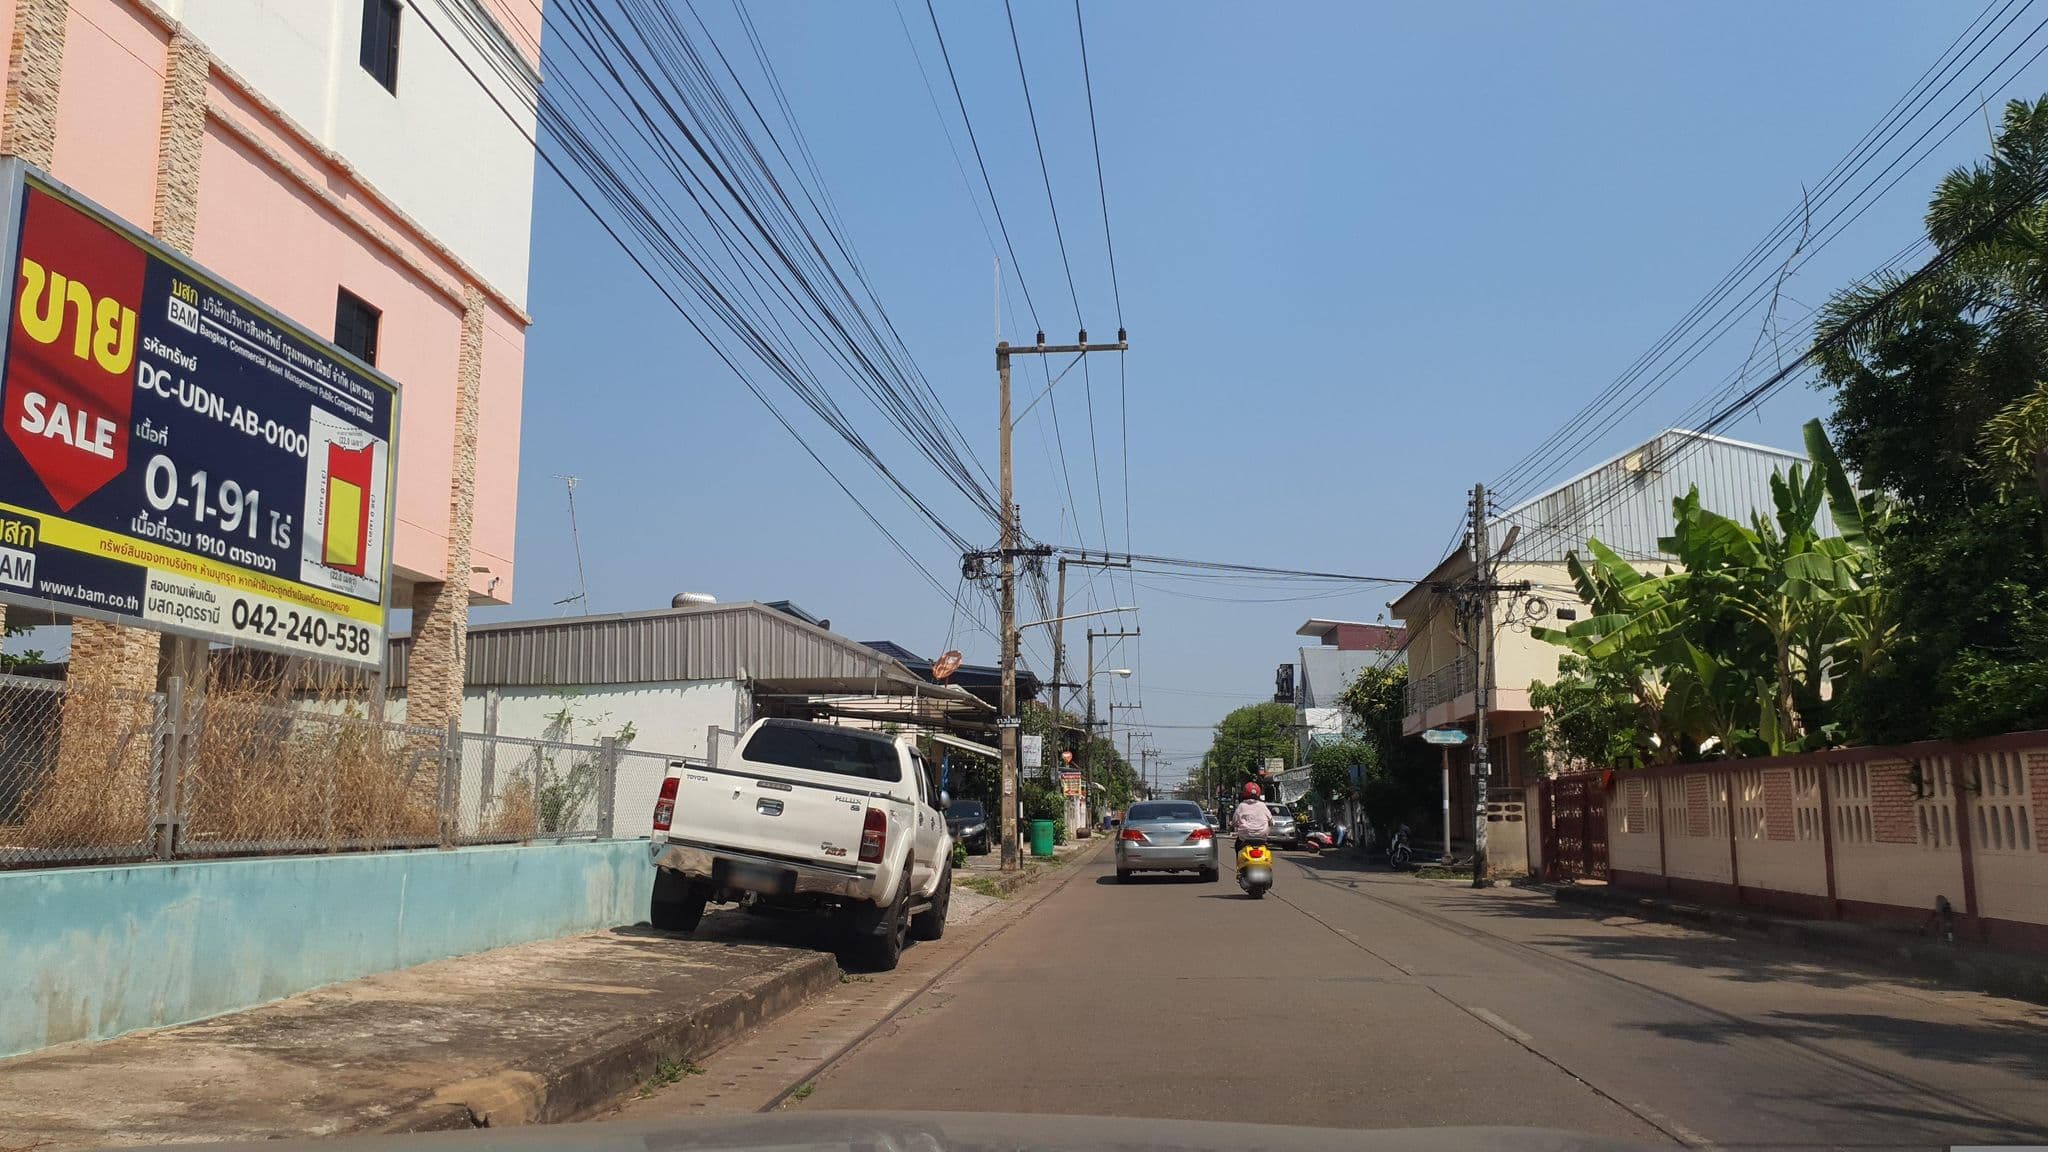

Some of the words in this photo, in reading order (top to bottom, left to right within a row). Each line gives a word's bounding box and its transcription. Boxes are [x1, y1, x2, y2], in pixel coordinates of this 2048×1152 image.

[20, 257, 136, 375] ขาย
[170, 301, 197, 329] BAM
[172, 278, 198, 306] บสก
[143, 337, 198, 372] รหัสทรัพย์
[200, 323, 228, 347] Bangkok
[230, 340, 266, 366] Commercial
[267, 360, 283, 377] Asset
[284, 368, 318, 395] Management
[319, 386, 334, 404] Public
[334, 395, 357, 416] Company
[20, 392, 116, 459] SALE
[136, 418, 168, 447] เนื้อที่
[137, 360, 308, 458] DC-UDN-AB-0100
[145, 454, 260, 539] 0-1-91
[269, 510, 292, 549] ไร่
[0, 554, 32, 584] AM
[131, 509, 192, 548] เนื้อที่รวม
[229, 546, 277, 573] ตารางวา
[39, 580, 139, 611] www.bam.co.th
[232, 598, 370, 656] 042-240-538
